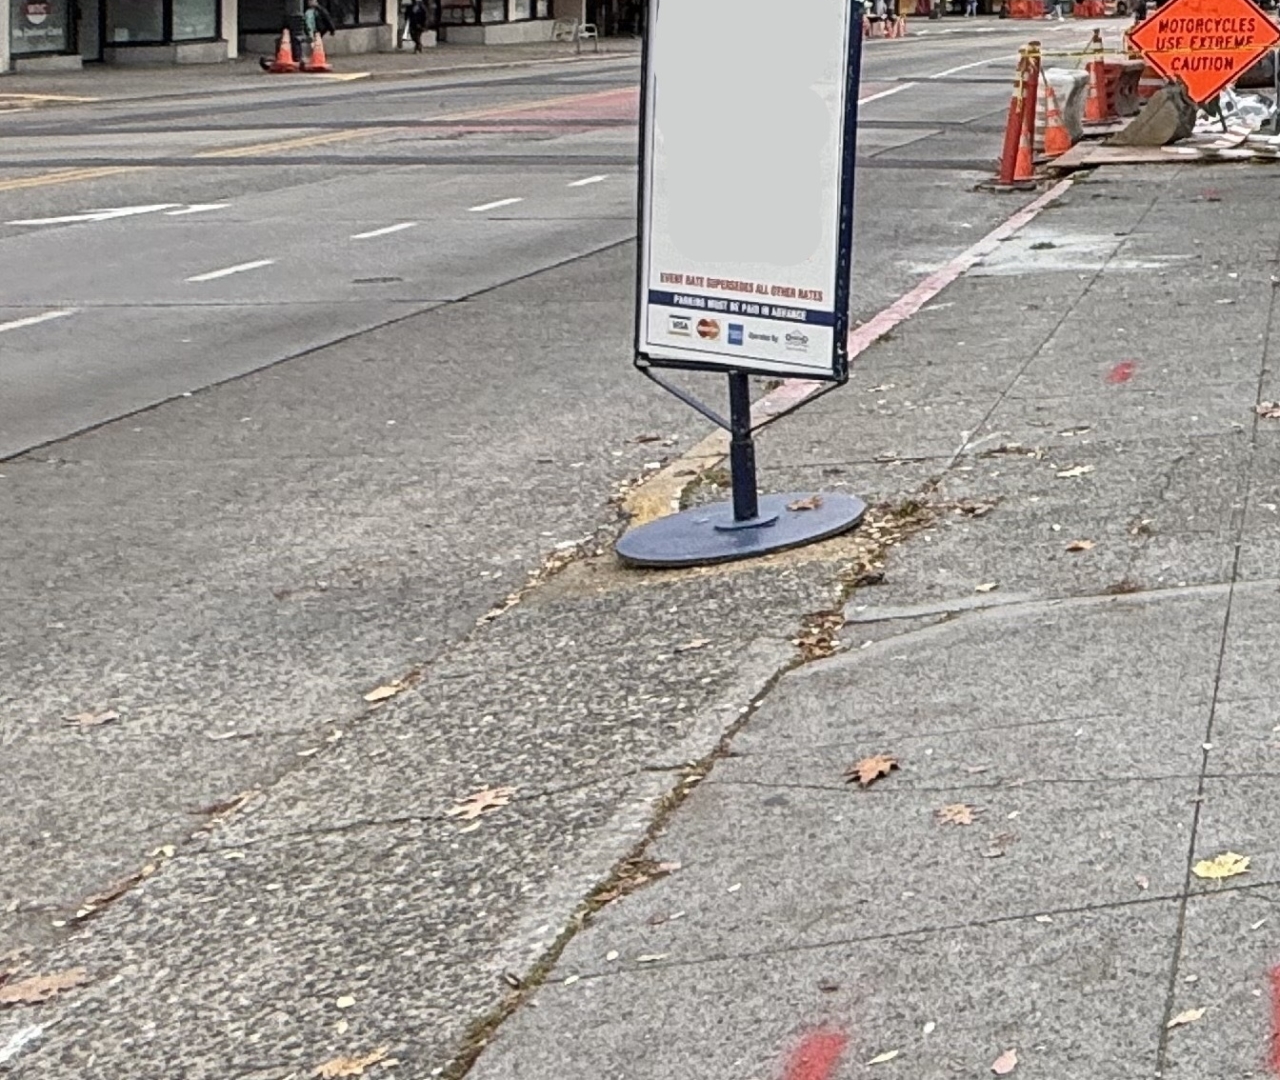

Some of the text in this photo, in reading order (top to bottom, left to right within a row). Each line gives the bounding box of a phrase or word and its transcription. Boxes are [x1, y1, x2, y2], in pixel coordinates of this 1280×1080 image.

[1158, 17, 1256, 34] MOTORCYCLES
[1156, 35, 1255, 51] USE EXTREME
[1170, 56, 1234, 72] CAUTION
[659, 271, 824, 303] EVENT RATE SUPERSEDES ALL OTHER RATES
[673, 293, 706, 309] PARKING
[707, 298, 729, 311] MUST
[741, 301, 760, 315] PAID
[771, 305, 808, 321] ADVANCE
[672, 320, 690, 331] VISA
